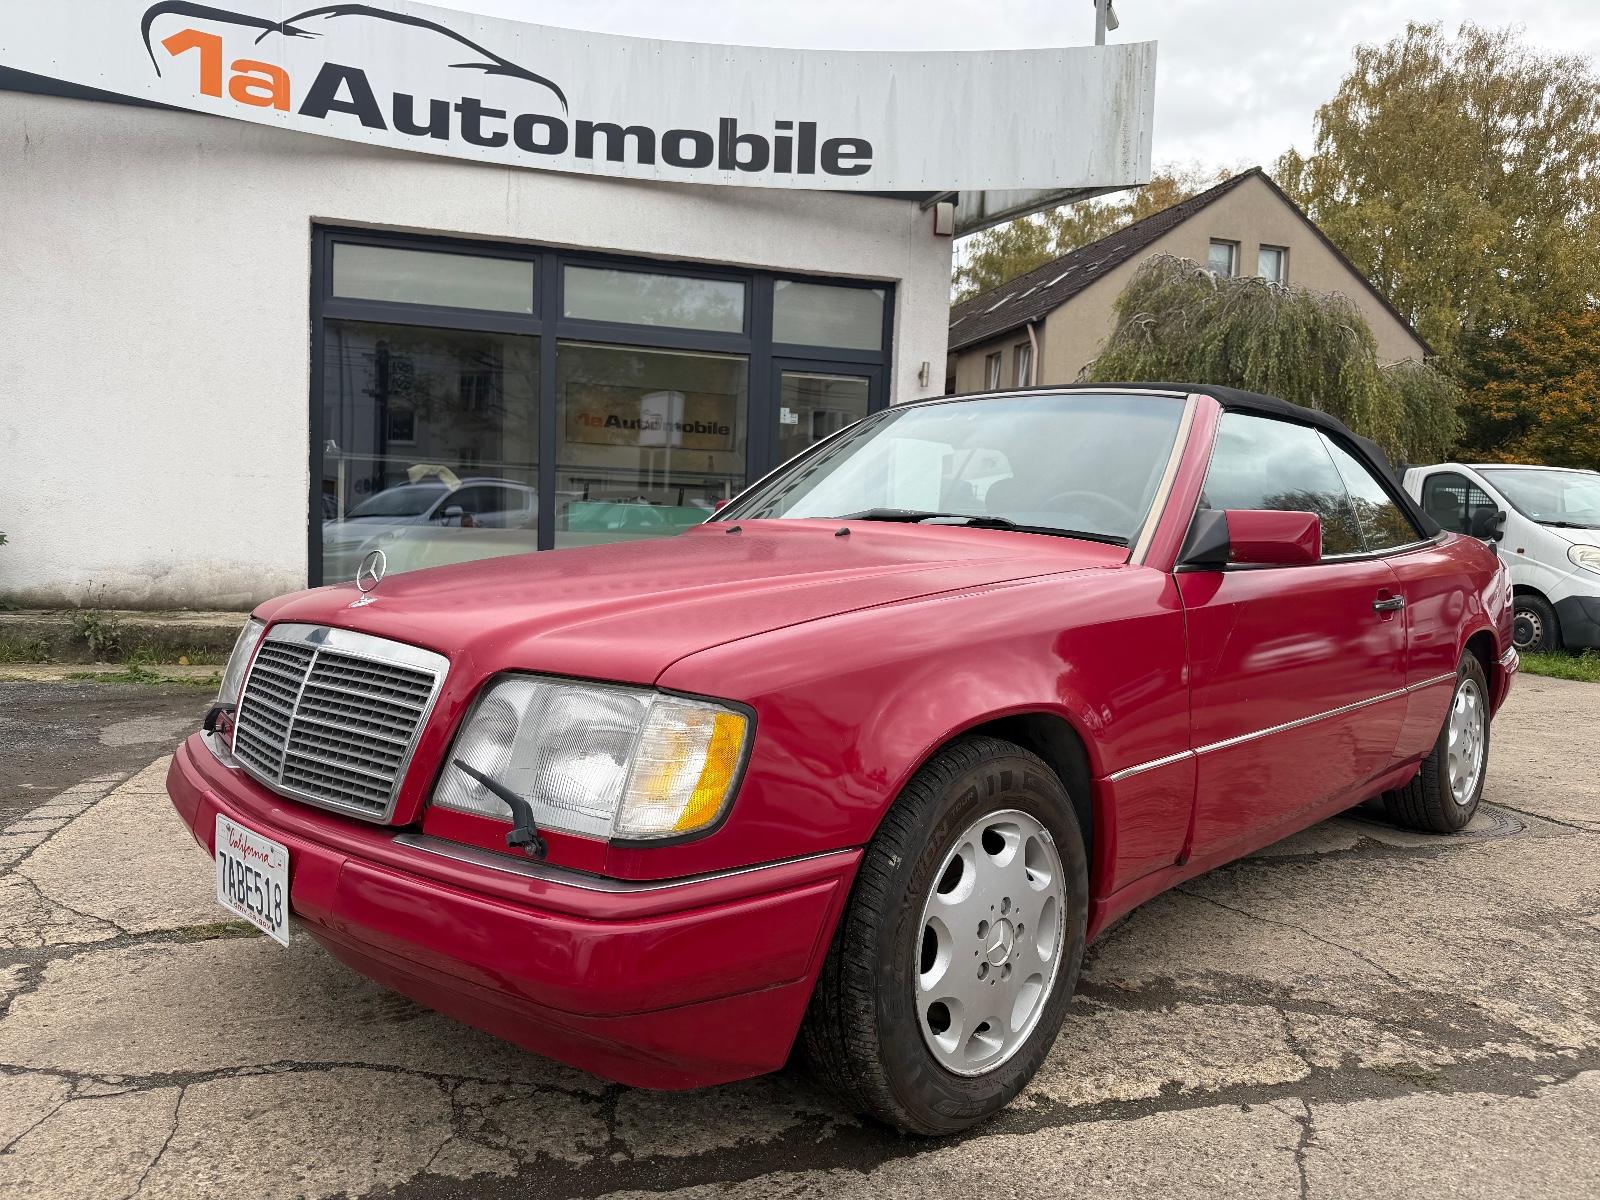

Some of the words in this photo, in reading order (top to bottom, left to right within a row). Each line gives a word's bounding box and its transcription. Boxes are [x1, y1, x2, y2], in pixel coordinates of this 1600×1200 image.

[161, 28, 873, 176] 1aAutomobile
[228, 827, 275, 869] California
[219, 850, 283, 928] 7ABE518
